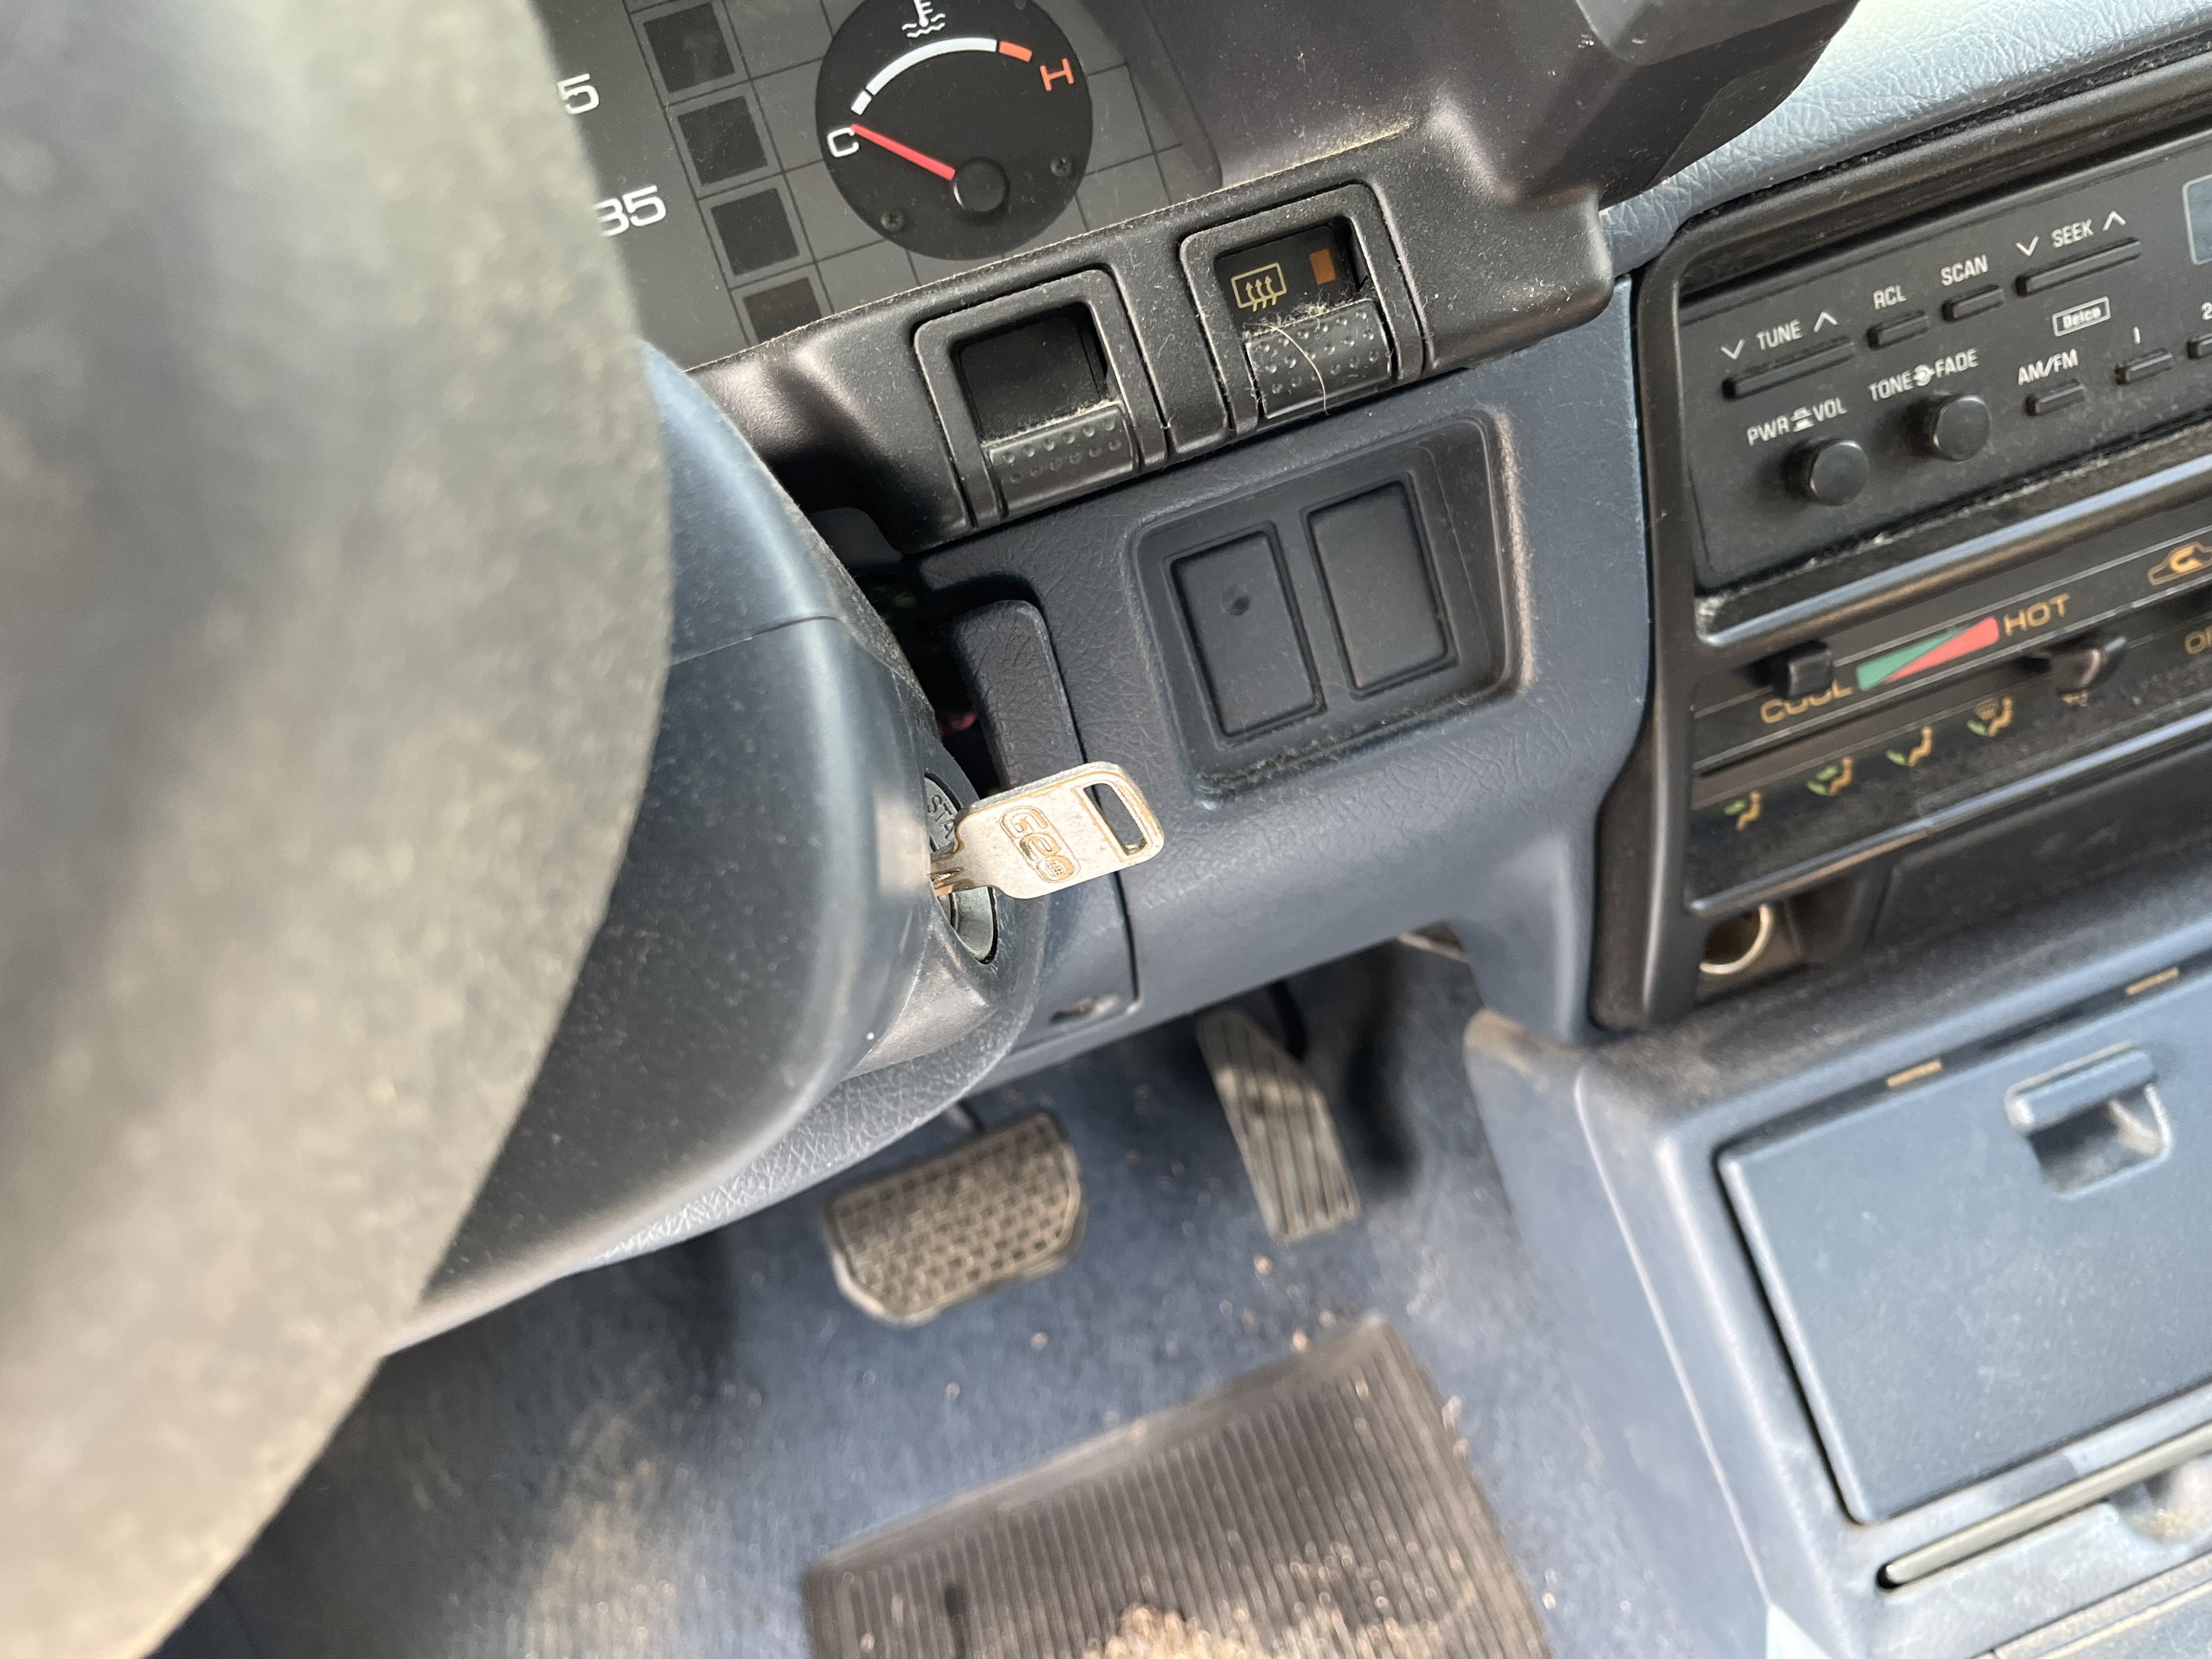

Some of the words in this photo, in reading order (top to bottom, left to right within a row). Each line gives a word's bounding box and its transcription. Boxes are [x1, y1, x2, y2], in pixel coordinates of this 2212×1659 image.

[1040, 58, 1074, 91] H
[827, 127, 860, 157] C
[2052, 219, 2094, 247] SEEK
[1941, 254, 1988, 286] SCAN
[1874, 285, 1907, 309] RCL
[1756, 319, 1803, 350] TUNE
[2018, 348, 2078, 385] AM/FM
[1747, 415, 1790, 445] PWR
[1813, 397, 1847, 422] VOL
[2004, 592, 2070, 635] HOT
